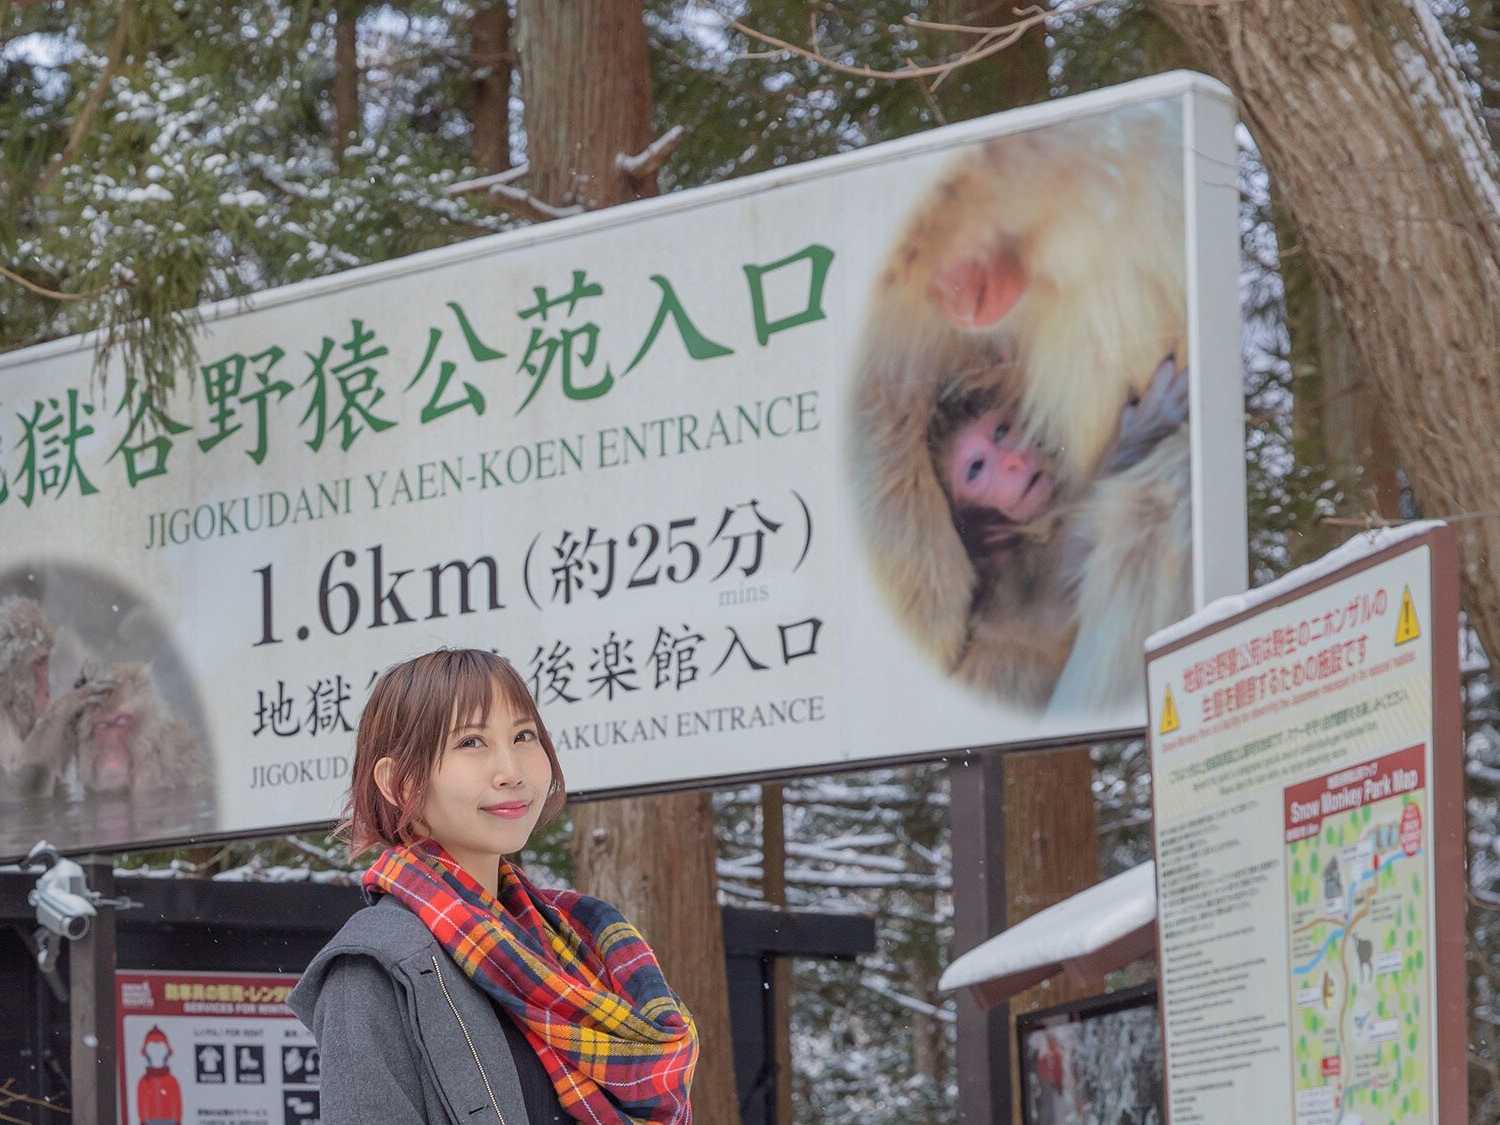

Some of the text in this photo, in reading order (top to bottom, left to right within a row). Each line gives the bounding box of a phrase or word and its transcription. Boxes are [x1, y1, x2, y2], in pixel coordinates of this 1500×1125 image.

[145, 391, 821, 550] JIGOKUDANI YAEN-KOEN ENTRANCE
[719, 585, 769, 607] mins
[250, 755, 349, 789] JIGOKUD
[677, 696, 826, 737] ENTRANCE
[1291, 800, 1320, 824] Snow
[1321, 787, 1362, 814] Monkey
[1363, 774, 1392, 800] Park
[1392, 768, 1419, 792] Map
